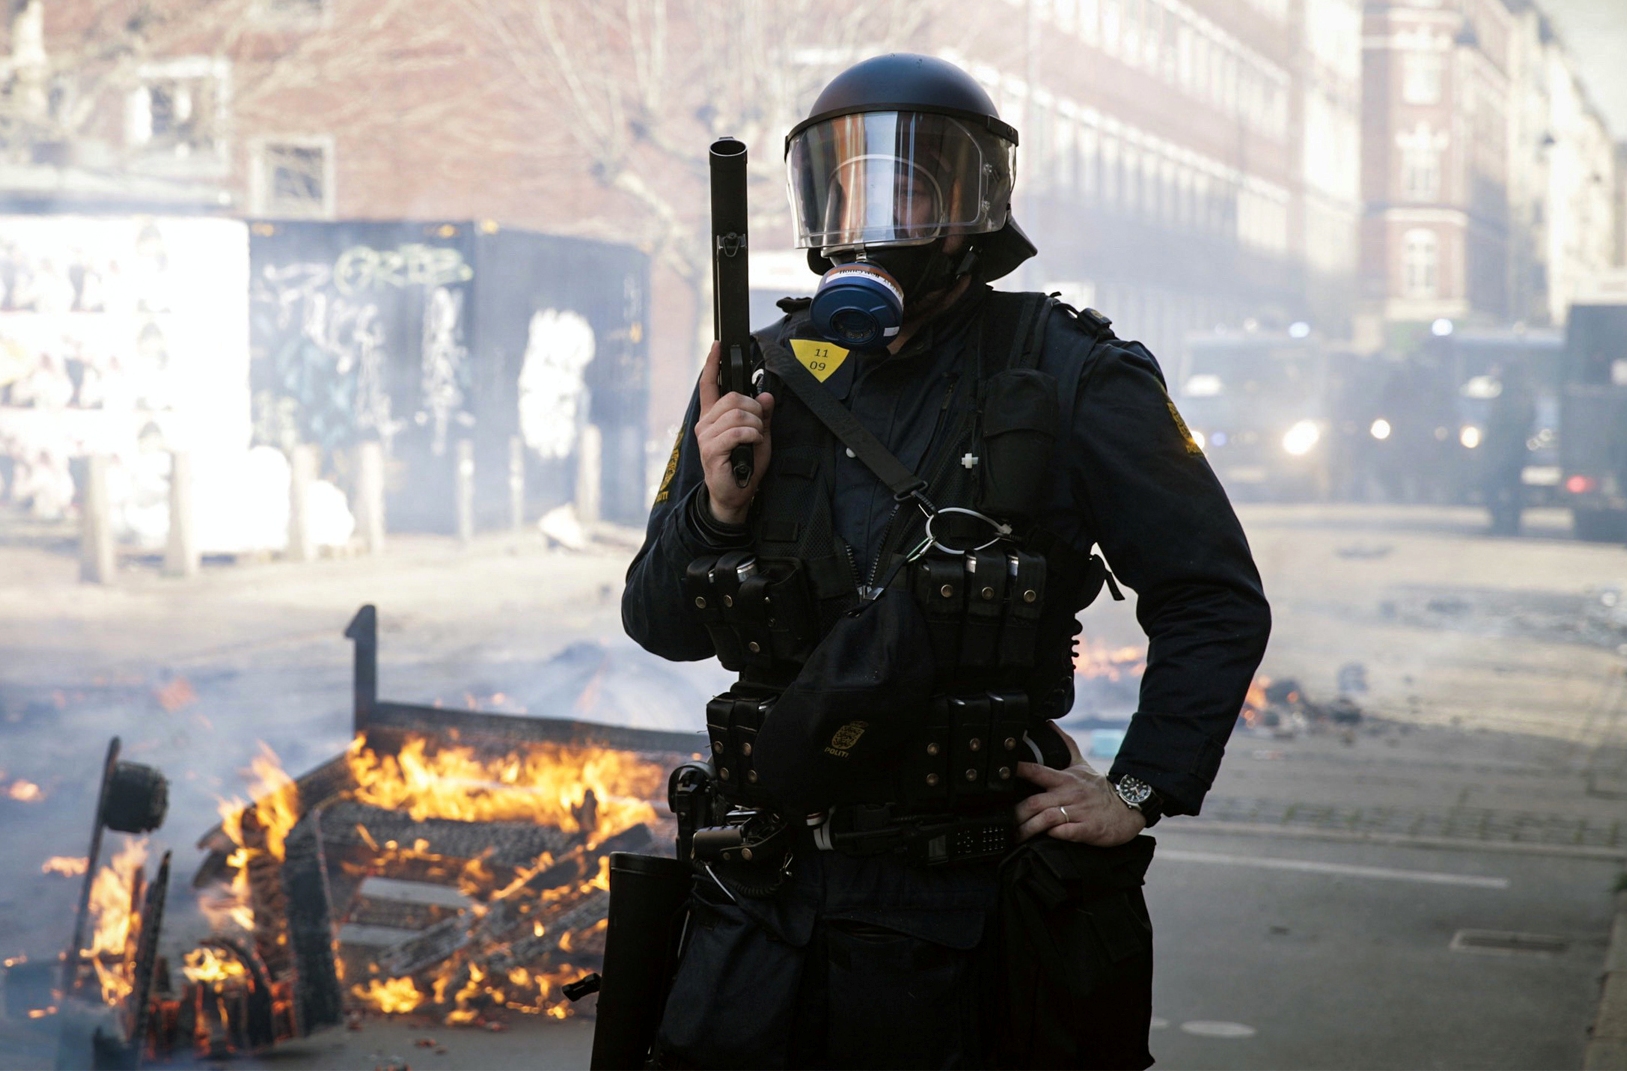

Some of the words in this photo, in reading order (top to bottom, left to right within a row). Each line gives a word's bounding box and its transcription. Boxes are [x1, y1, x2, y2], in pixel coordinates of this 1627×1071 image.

[815, 349, 828, 357] 11
[809, 361, 826, 371] 09
[824, 747, 849, 758] POLITI
